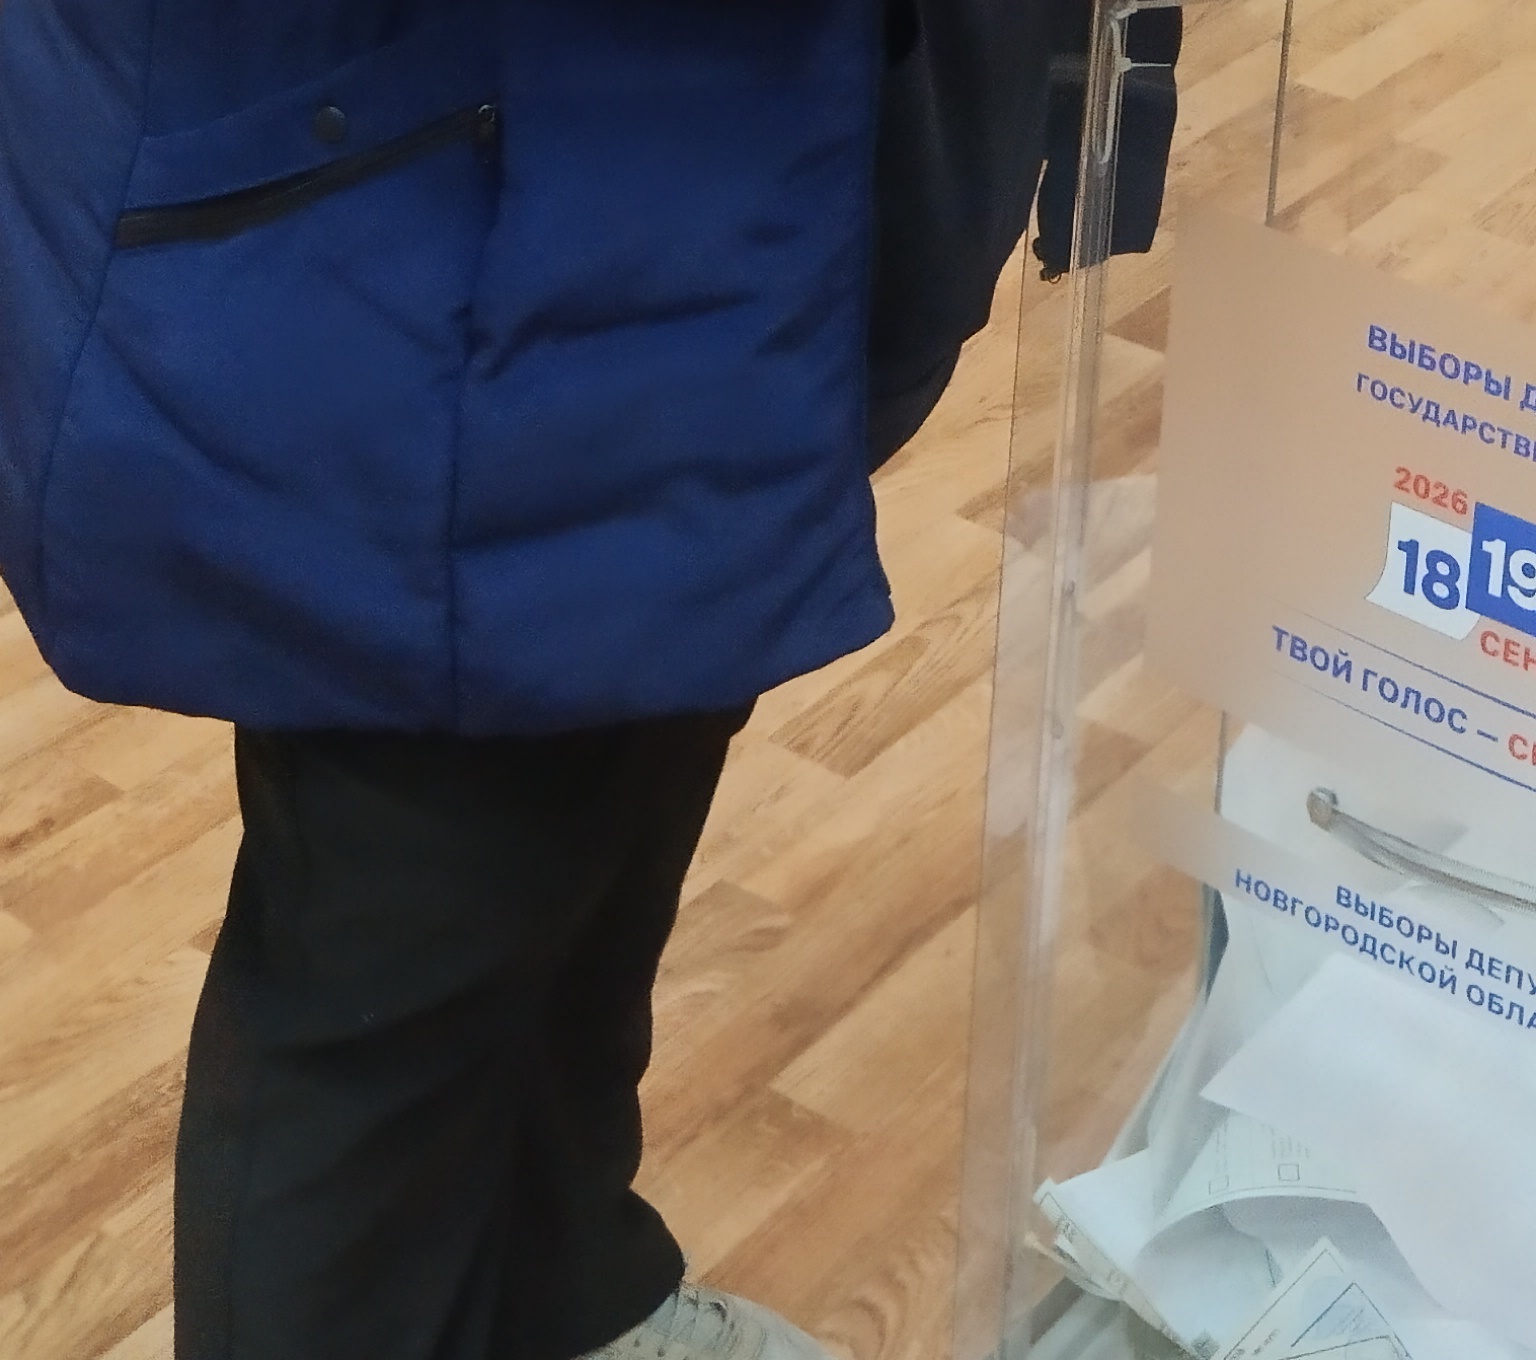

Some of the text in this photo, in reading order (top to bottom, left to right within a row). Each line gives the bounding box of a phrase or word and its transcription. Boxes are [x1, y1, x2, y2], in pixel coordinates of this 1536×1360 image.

[1368, 324, 1511, 400] ВЫБОРЫ
[1393, 466, 1468, 516] 2026
[1398, 539, 1460, 610] 18
[1272, 625, 1351, 684] ТВОЙ
[1361, 669, 1467, 734] ГОЛОС
[1235, 868, 1456, 995] НОВГОРОДСКОЙ
[1336, 886, 1457, 958] ВЫБОРЫ
